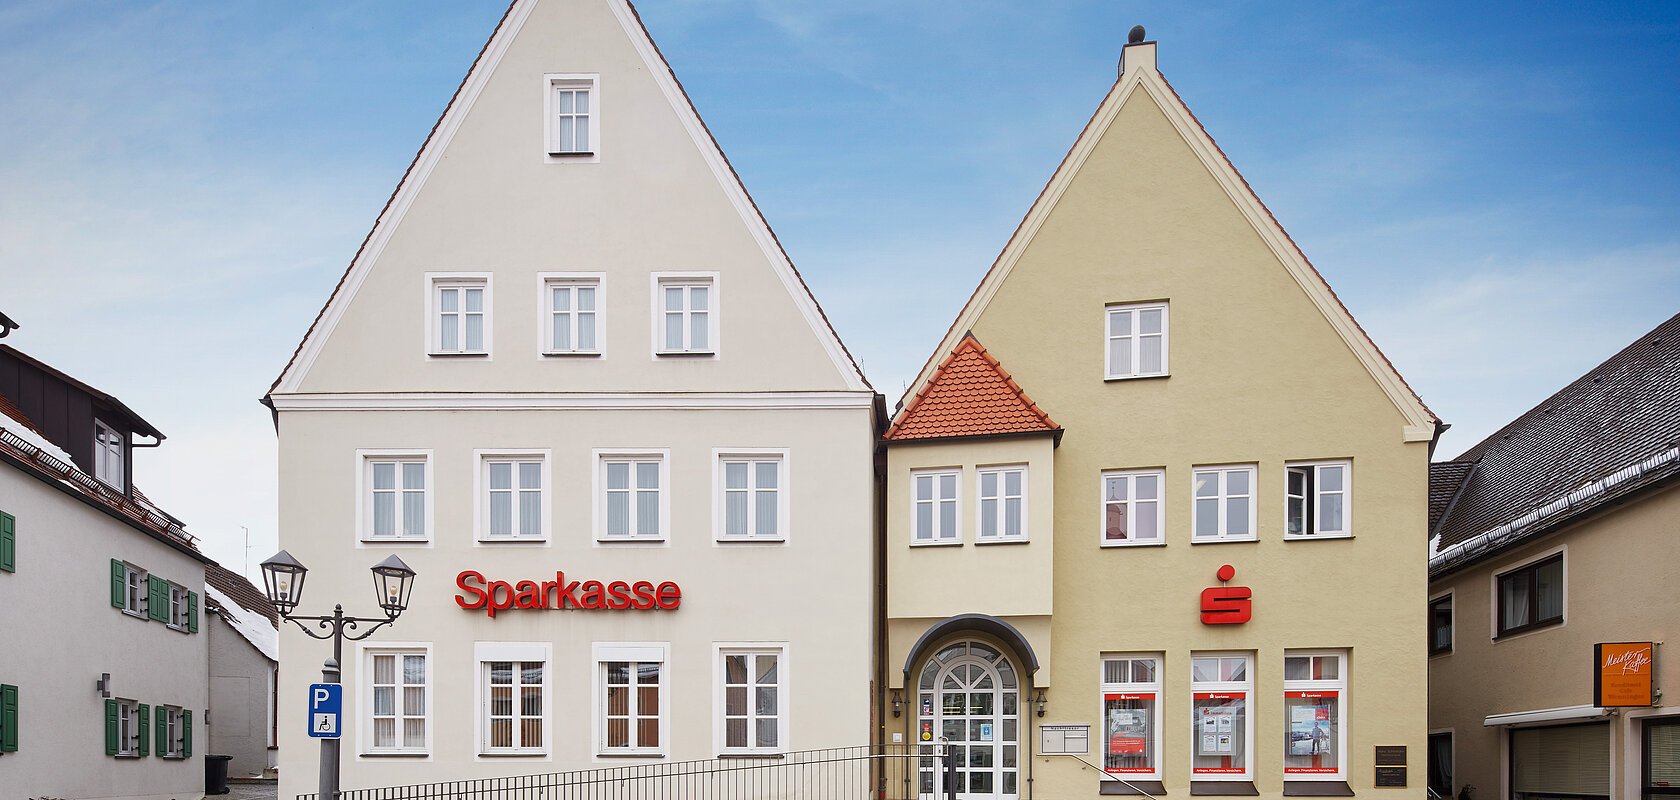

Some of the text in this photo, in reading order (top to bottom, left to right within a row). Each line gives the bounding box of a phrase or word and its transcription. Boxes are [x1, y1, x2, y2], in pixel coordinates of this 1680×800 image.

[455, 570, 682, 618] Sparkasse
[1603, 647, 1650, 668] Meister
[1622, 653, 1651, 676] Kaffee
[314, 688, 330, 709] P
